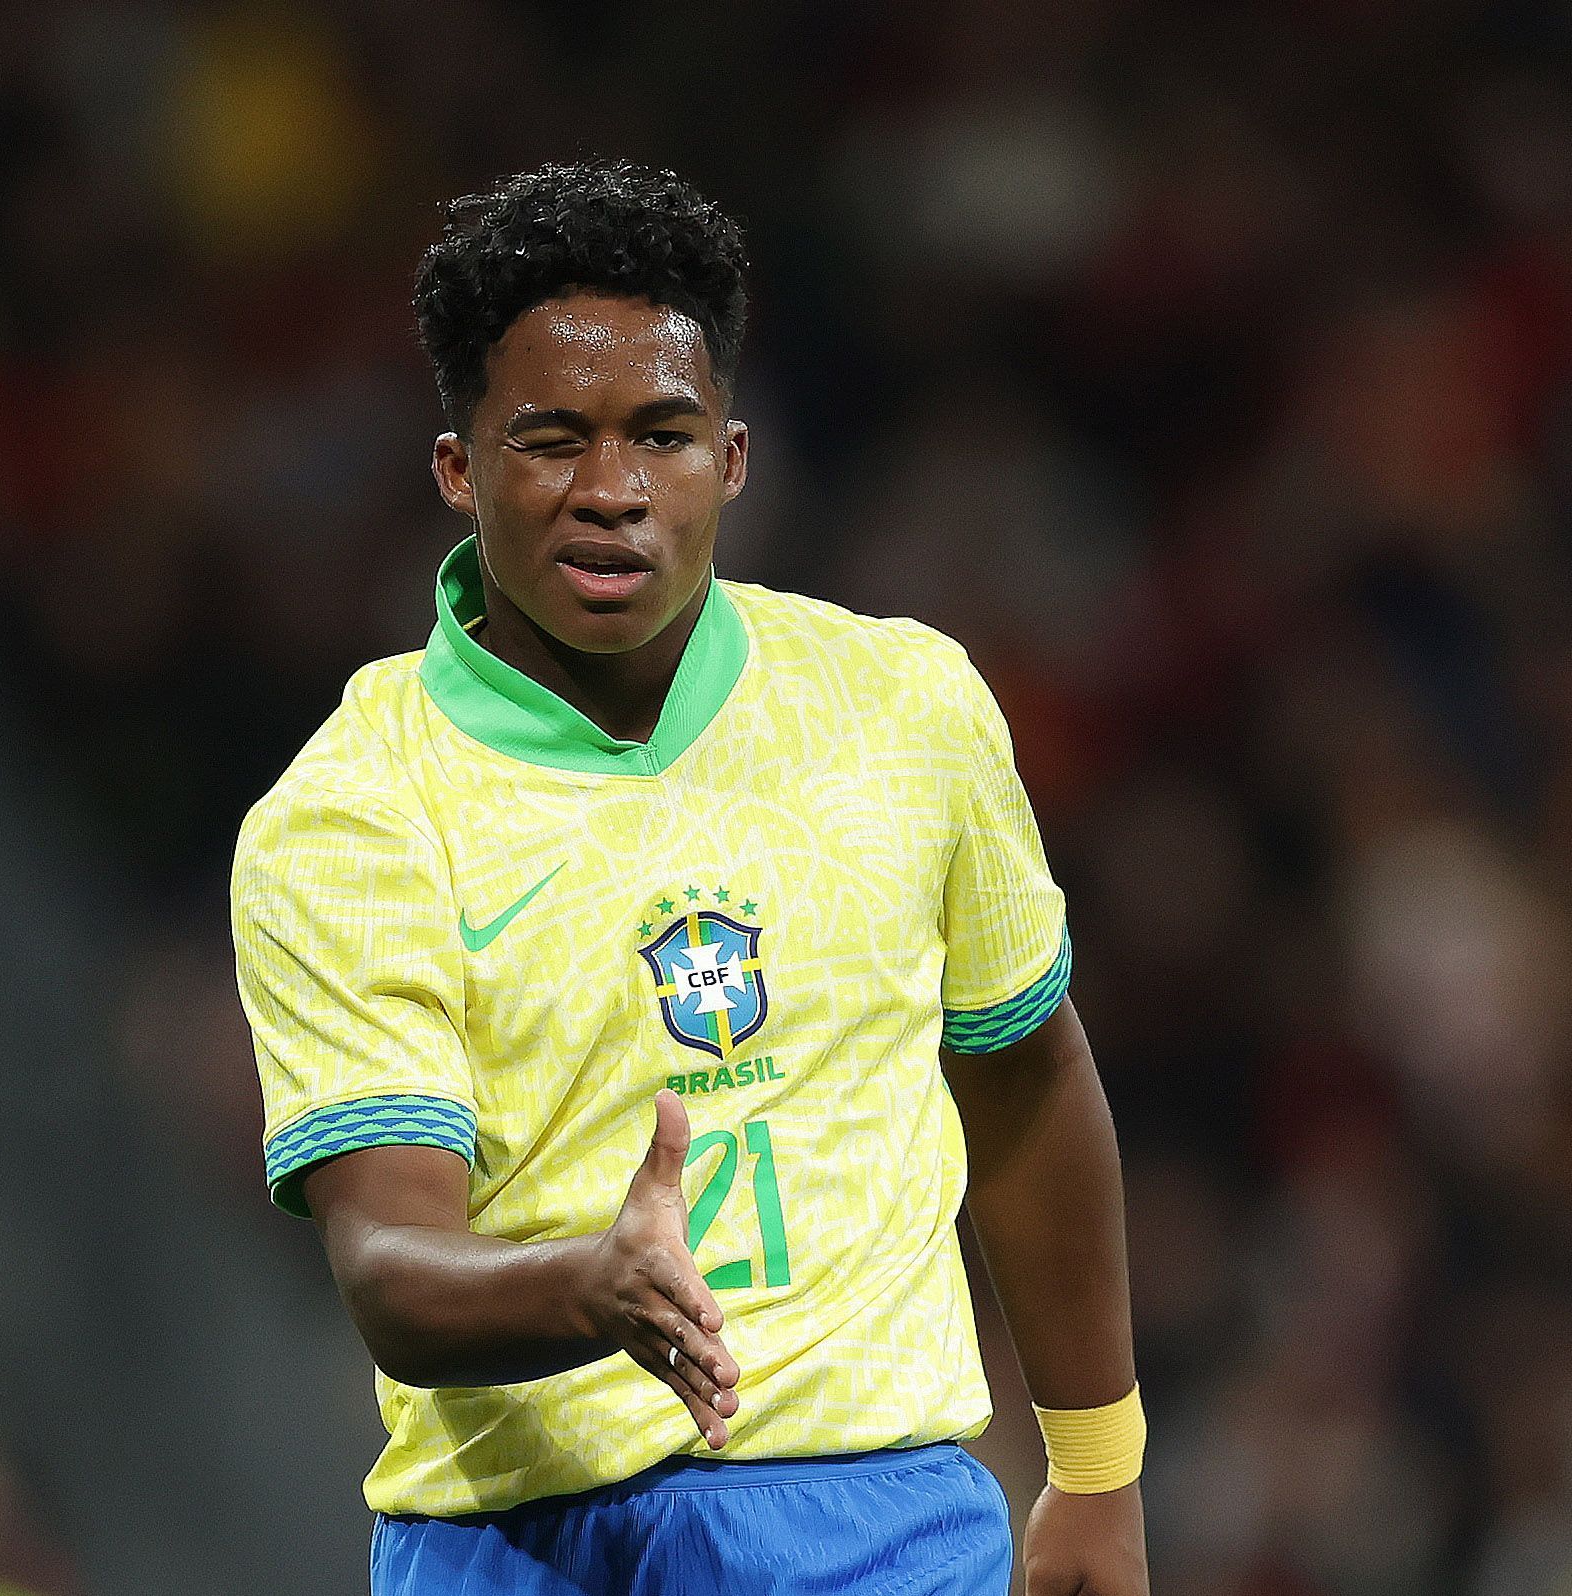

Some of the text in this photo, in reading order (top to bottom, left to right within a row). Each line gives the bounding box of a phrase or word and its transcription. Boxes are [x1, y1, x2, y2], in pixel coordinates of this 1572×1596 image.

[687, 966, 730, 989] CBF
[666, 1055, 786, 1096] BRASIL
[684, 1120, 791, 1290] 21
